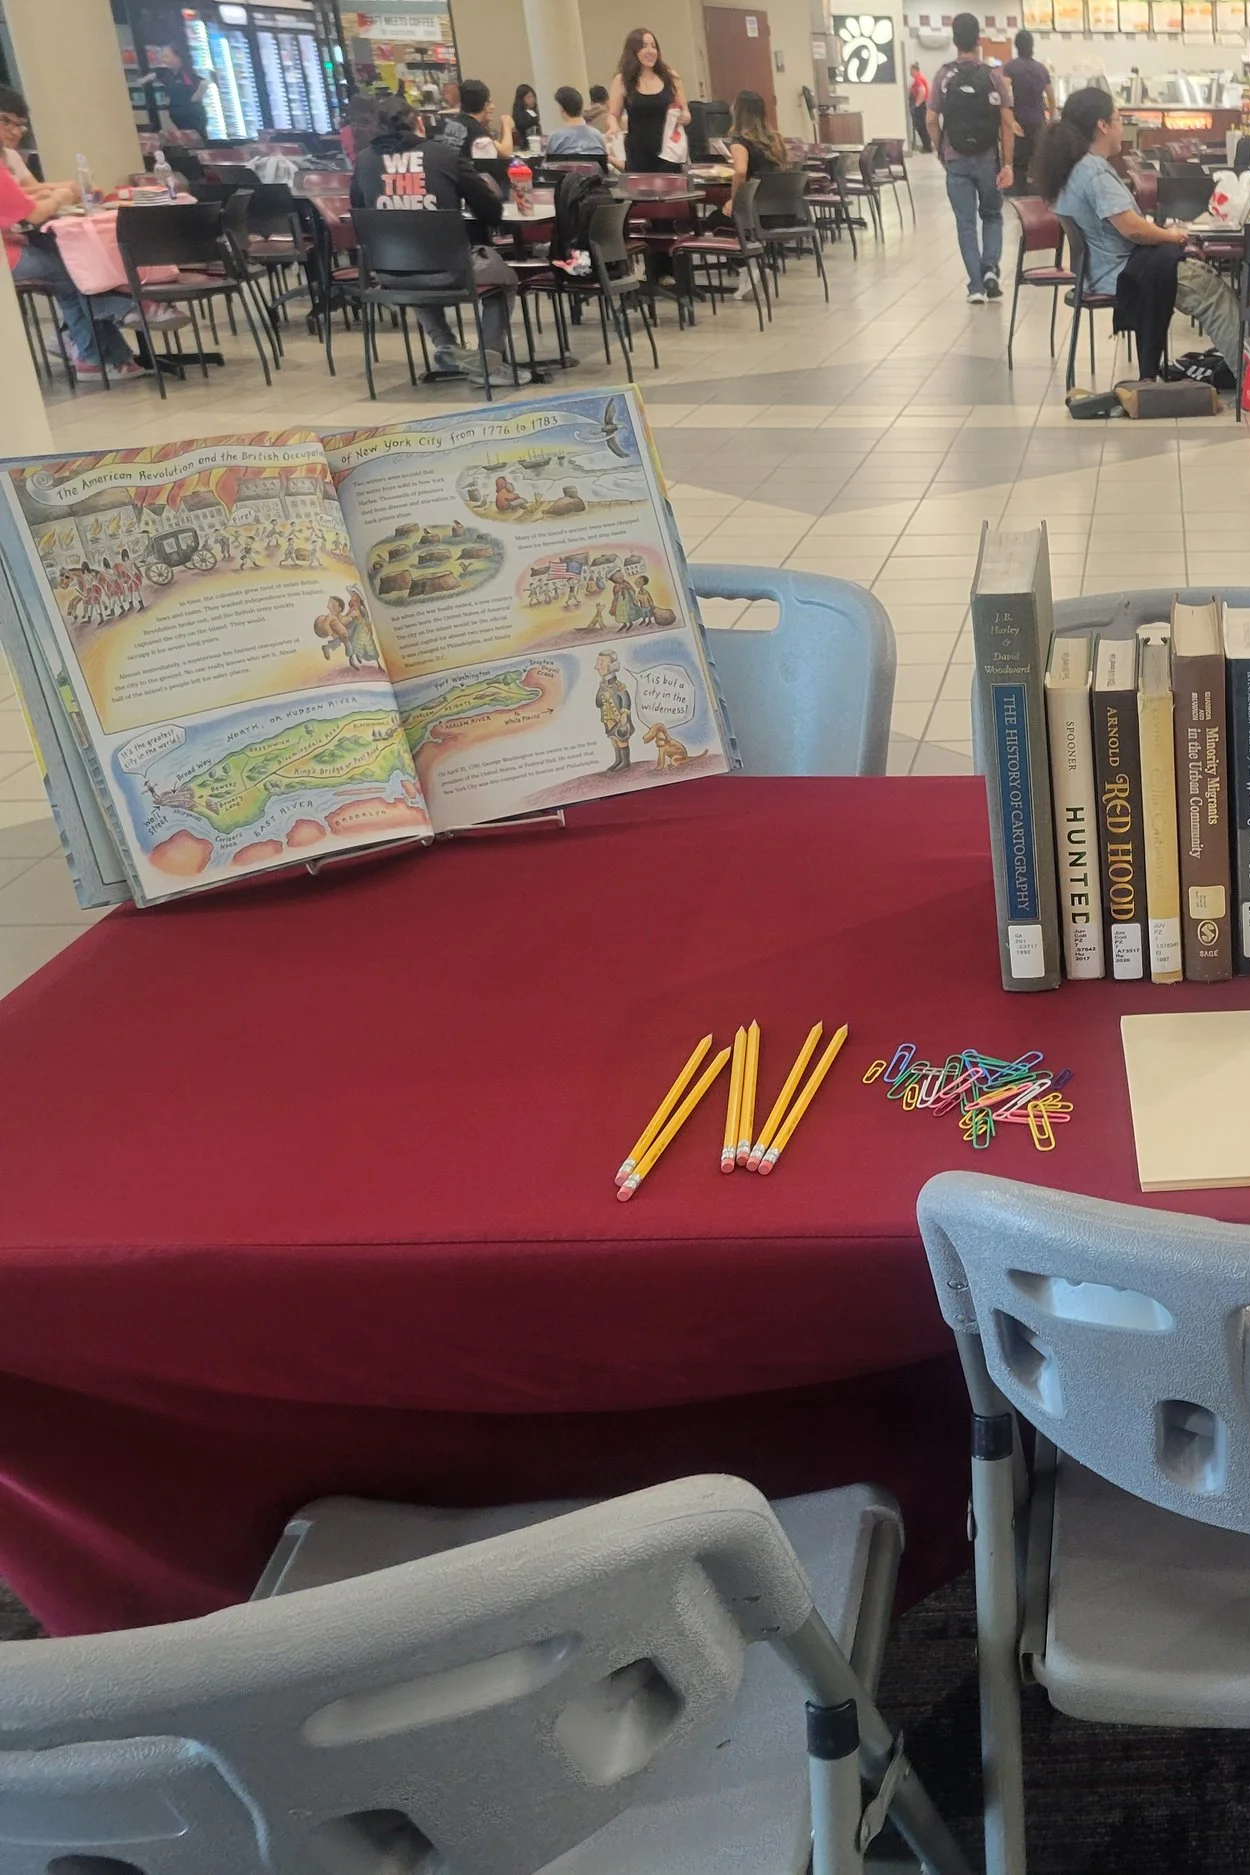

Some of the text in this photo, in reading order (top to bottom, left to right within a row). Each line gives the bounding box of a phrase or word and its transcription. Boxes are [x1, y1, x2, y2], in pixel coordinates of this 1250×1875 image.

[382, 152, 424, 174] WE
[381, 172, 427, 196] THE
[376, 194, 438, 210] ONES
[341, 415, 558, 465] of New York City from 1776 to 1783
[57, 486, 78, 501] The
[82, 473, 132, 492] American
[138, 461, 195, 481] Revolution
[198, 452, 217, 465] and
[221, 451, 239, 462] the
[241, 451, 279, 463] British
[991, 626, 1020, 636] Harley
[1002, 638, 1012, 646] &
[994, 652, 1020, 660] David
[435, 670, 491, 689] Fort Washington
[984, 664, 1031, 674] Woodward
[663, 674, 678, 687] but
[644, 687, 661, 700] city
[673, 692, 686, 704] the
[286, 705, 324, 719] HUDSON
[328, 697, 358, 709] RIVER
[642, 702, 688, 715] wilderness!
[134, 742, 146, 751] the
[148, 728, 175, 746] greatest
[1066, 721, 1077, 771] SPOONER
[124, 757, 138, 768] city
[146, 747, 157, 756] the
[158, 734, 180, 750] world!
[176, 758, 212, 783] Broad Way
[294, 766, 316, 776] King's
[319, 764, 344, 776] Bridge
[1206, 727, 1220, 825] Minority Migrants
[1004, 694, 1030, 910] THE HISTORY OF CARTOGRAPHY
[1188, 728, 1204, 859] in the Urban Community
[143, 812, 162, 828] Wall
[254, 801, 314, 838] EAST RIVER
[335, 810, 387, 828] BROOKLYN
[1102, 706, 1135, 920] ARNOLD RED HOOD
[148, 816, 169, 836] Street
[1200, 950, 1218, 958] SAGE
